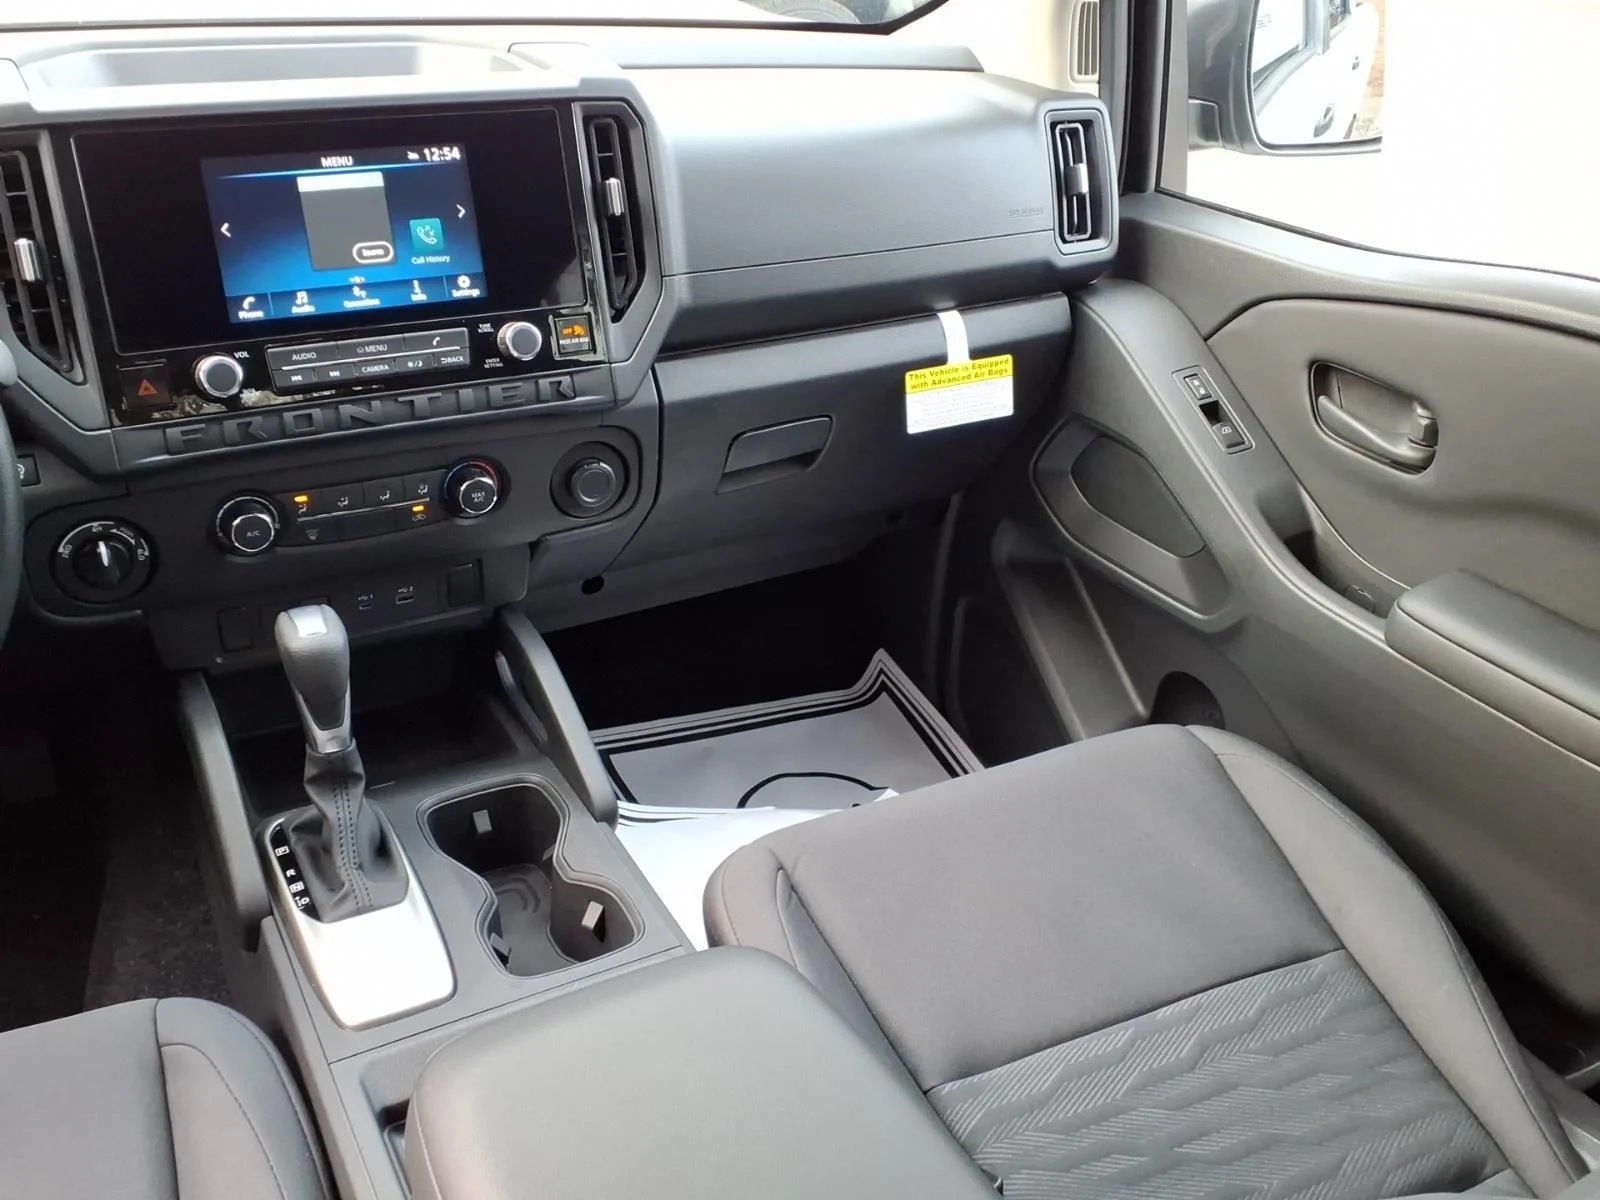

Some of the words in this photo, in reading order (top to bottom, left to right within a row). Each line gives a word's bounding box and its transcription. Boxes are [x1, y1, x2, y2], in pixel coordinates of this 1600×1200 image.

[424, 146, 461, 161] 12:54
[320, 155, 353, 168] MENU
[411, 256, 425, 264] Call
[426, 255, 450, 264] History
[365, 343, 388, 353] MENU
[233, 350, 250, 359] VOL
[291, 351, 317, 361] AUDIO
[447, 354, 465, 363] BACK
[361, 364, 390, 374] CAMERA
[909, 373, 926, 381] This
[929, 367, 959, 377] Vehicle
[972, 358, 1009, 371] Equipped
[911, 381, 929, 390] with
[931, 374, 971, 386] Advanced
[974, 369, 985, 378] Air
[988, 367, 1008, 378] Bags
[165, 375, 576, 455] FRONTIER
[286, 869, 296, 877] R
